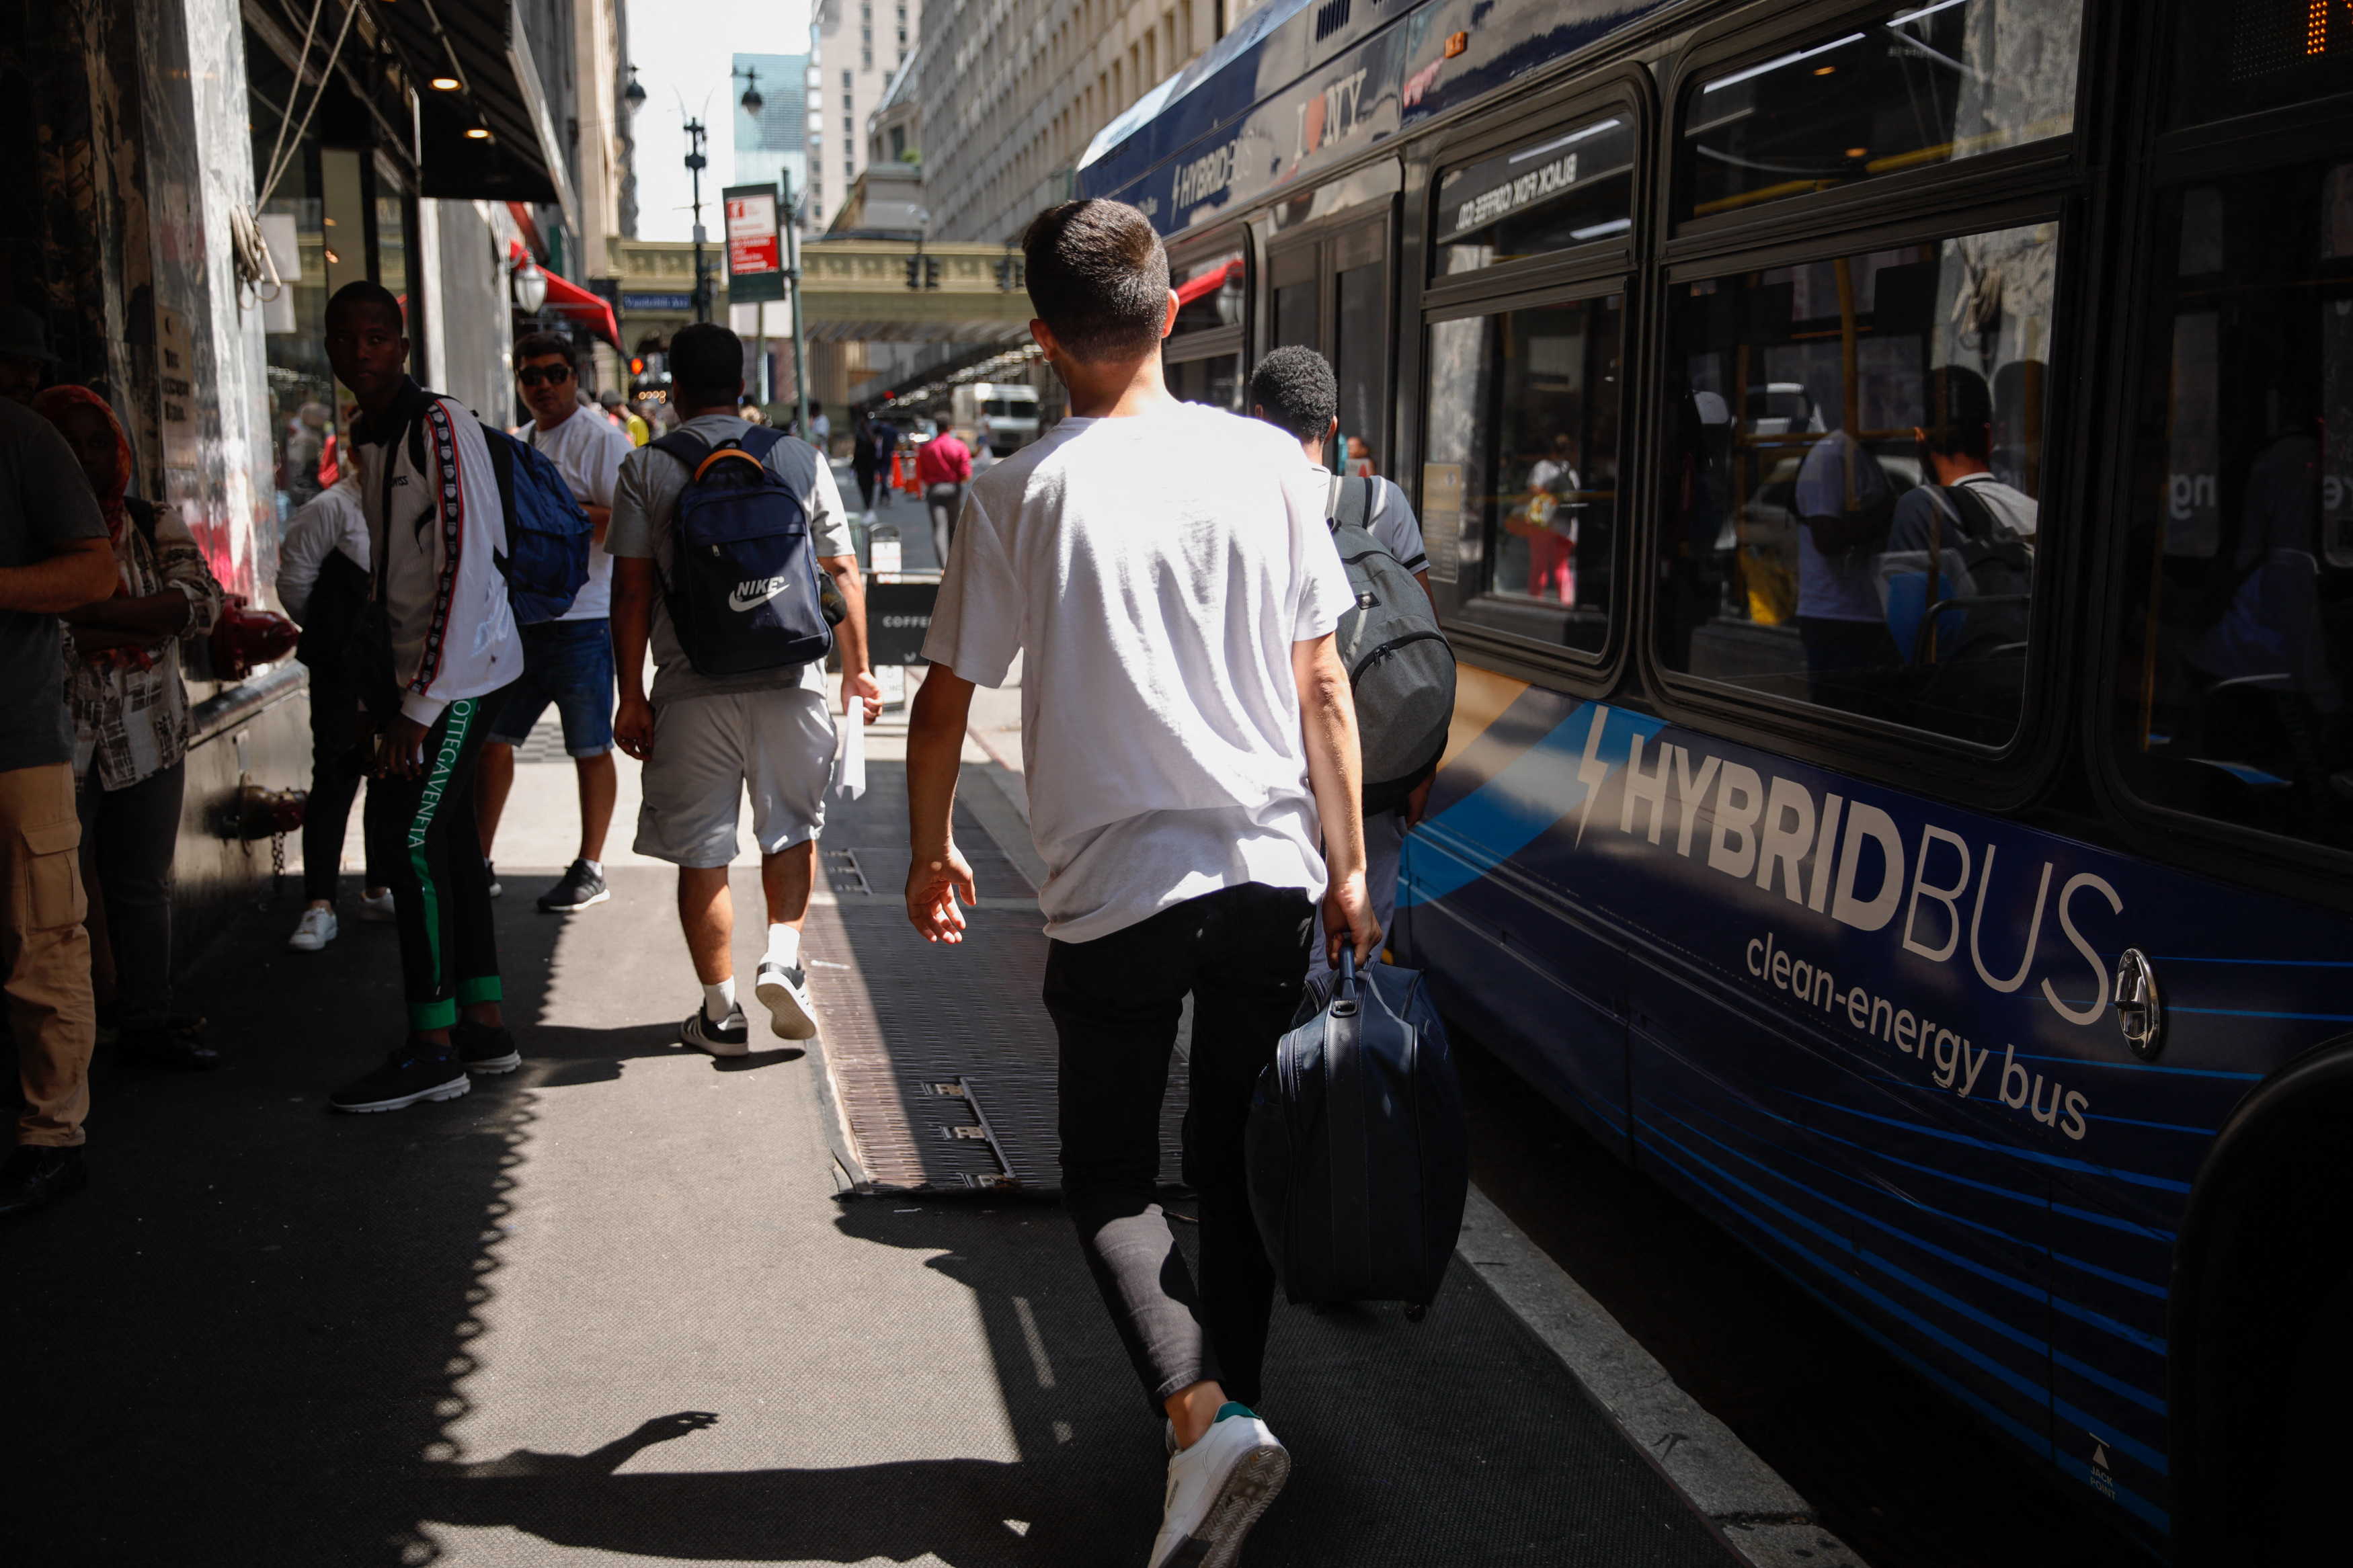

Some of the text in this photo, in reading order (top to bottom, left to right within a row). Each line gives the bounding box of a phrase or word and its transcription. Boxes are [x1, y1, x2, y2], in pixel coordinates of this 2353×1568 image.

[1293, 67, 1367, 161] I NY
[736, 576, 780, 596] NIKE
[1620, 733, 2124, 1026] HYBRIDBUS
[1747, 932, 2090, 1141] clean-energy bus
[2089, 1476, 2116, 1500] POINT
[2090, 1465, 2113, 1487] JACK
